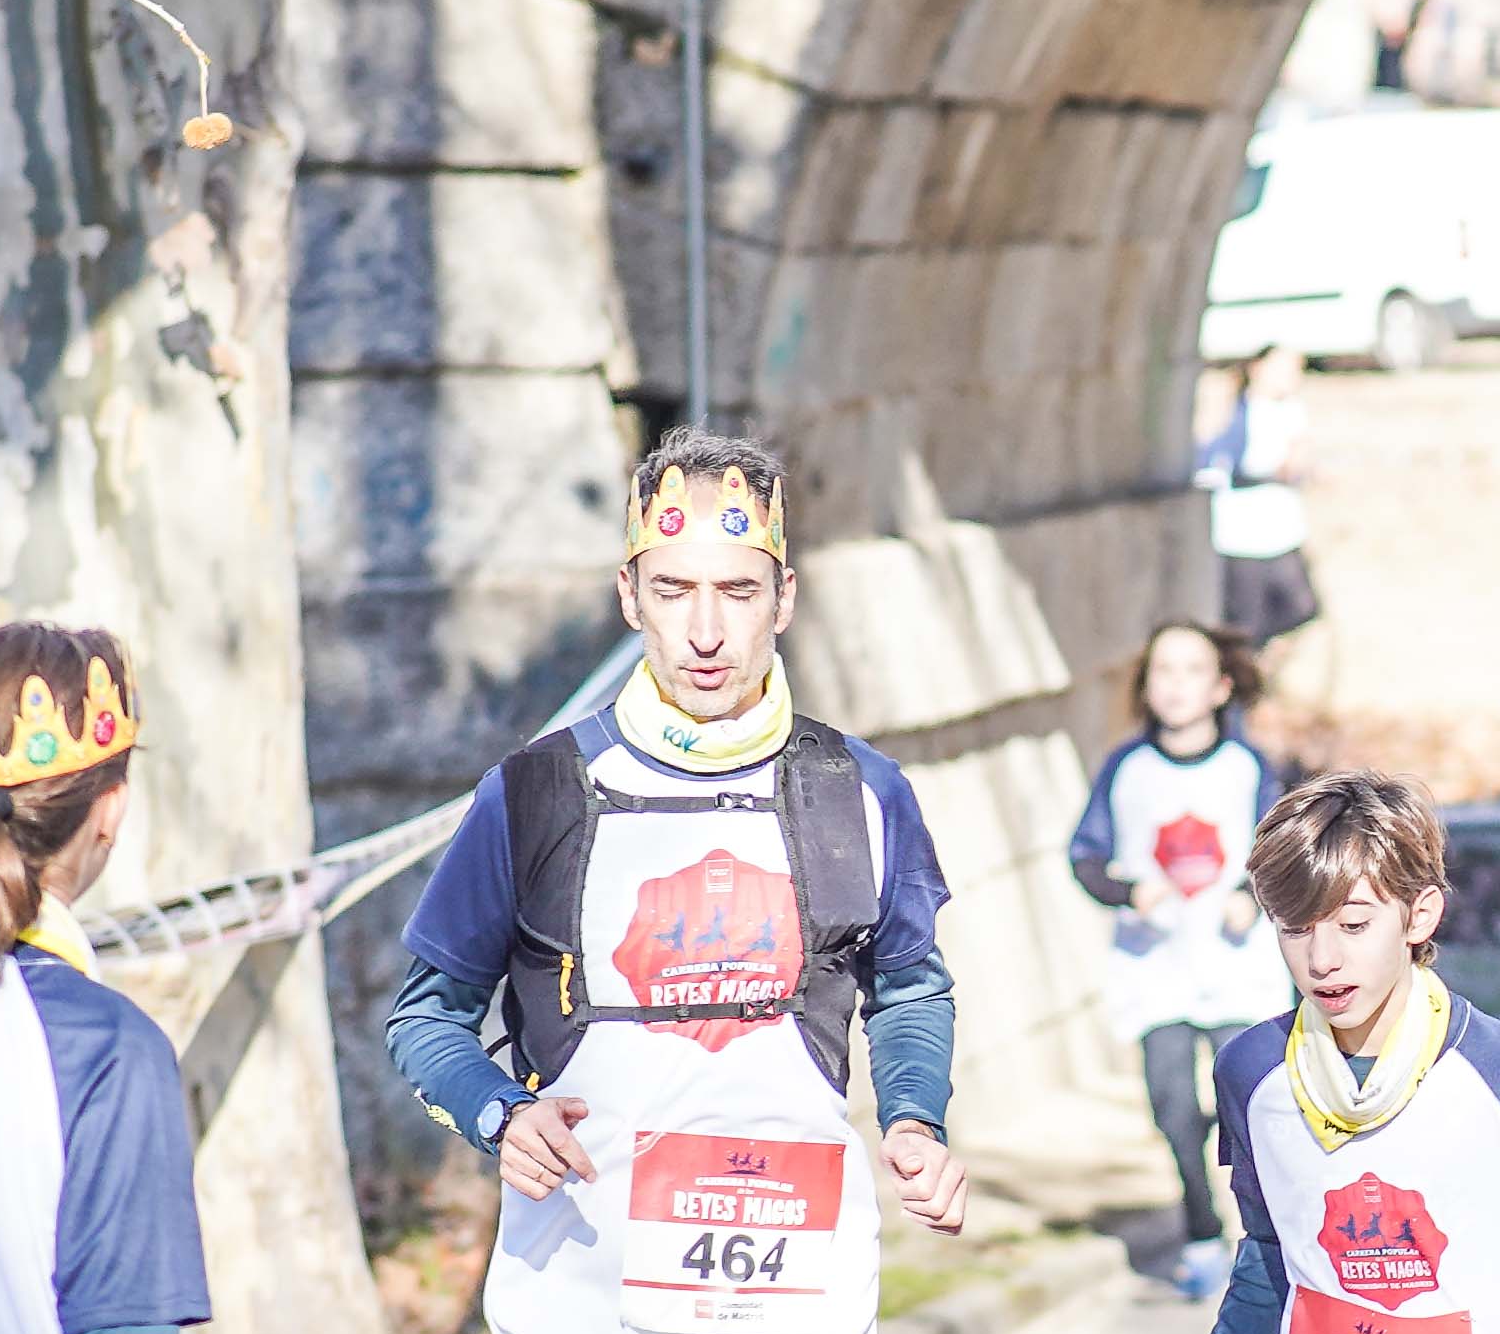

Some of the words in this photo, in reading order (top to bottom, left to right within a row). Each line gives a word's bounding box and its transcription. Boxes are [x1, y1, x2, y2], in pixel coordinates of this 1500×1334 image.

[650, 981, 713, 1007] REYES
[717, 979, 786, 1004] MAGOS
[671, 1189, 738, 1222] REYES
[742, 1196, 808, 1226] MAGOS
[682, 1232, 788, 1283] 464
[1340, 1260, 1381, 1280] REYES
[1383, 1259, 1432, 1280] MAGOS
